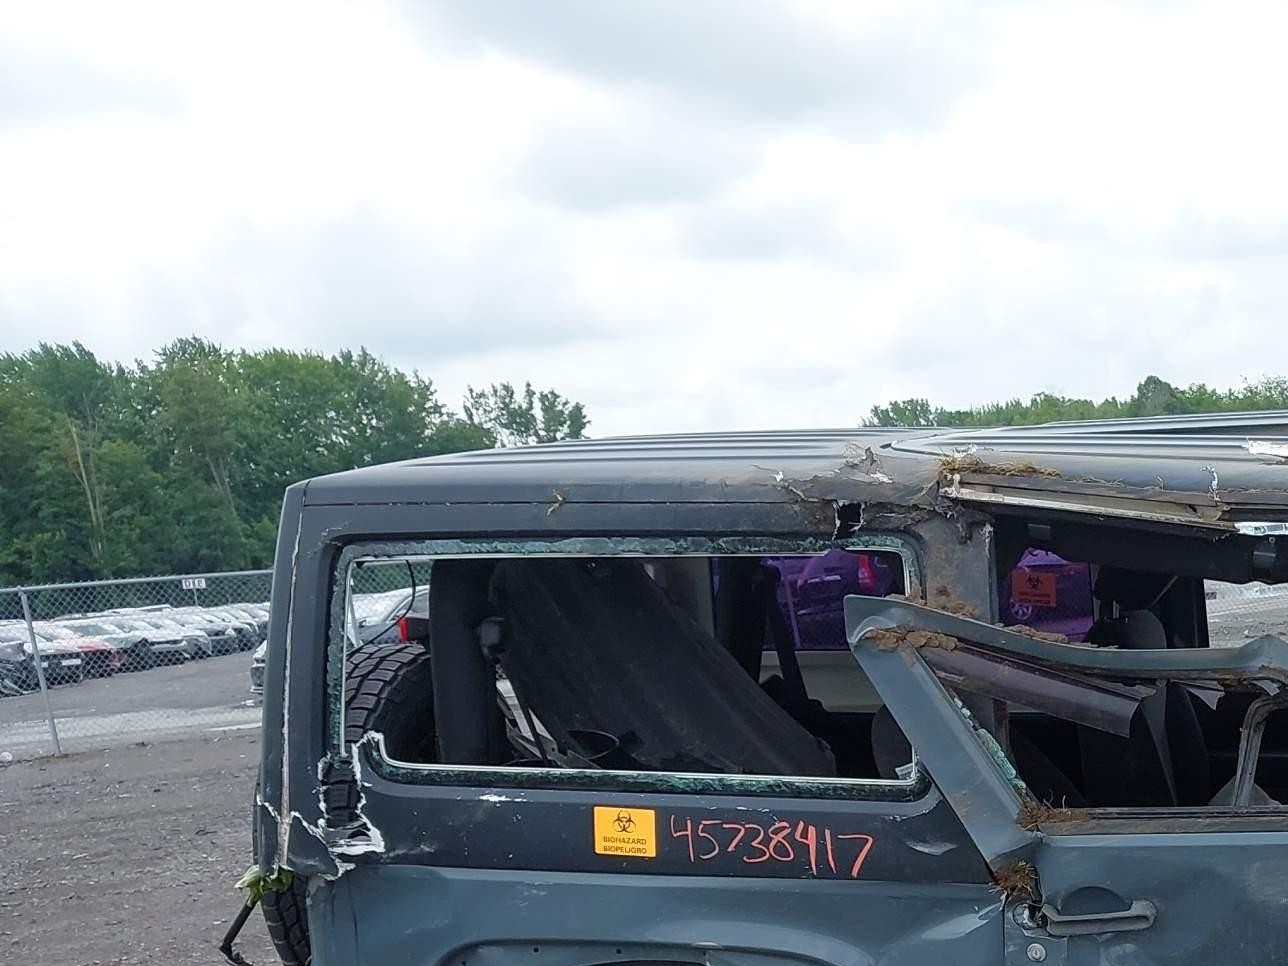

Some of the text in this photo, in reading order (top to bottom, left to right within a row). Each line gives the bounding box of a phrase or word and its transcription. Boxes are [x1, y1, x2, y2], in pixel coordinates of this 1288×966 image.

[602, 836, 648, 846] BIOHAZARD
[602, 845, 649, 855] BIOPELIGRO
[671, 815, 874, 878] 45738417
